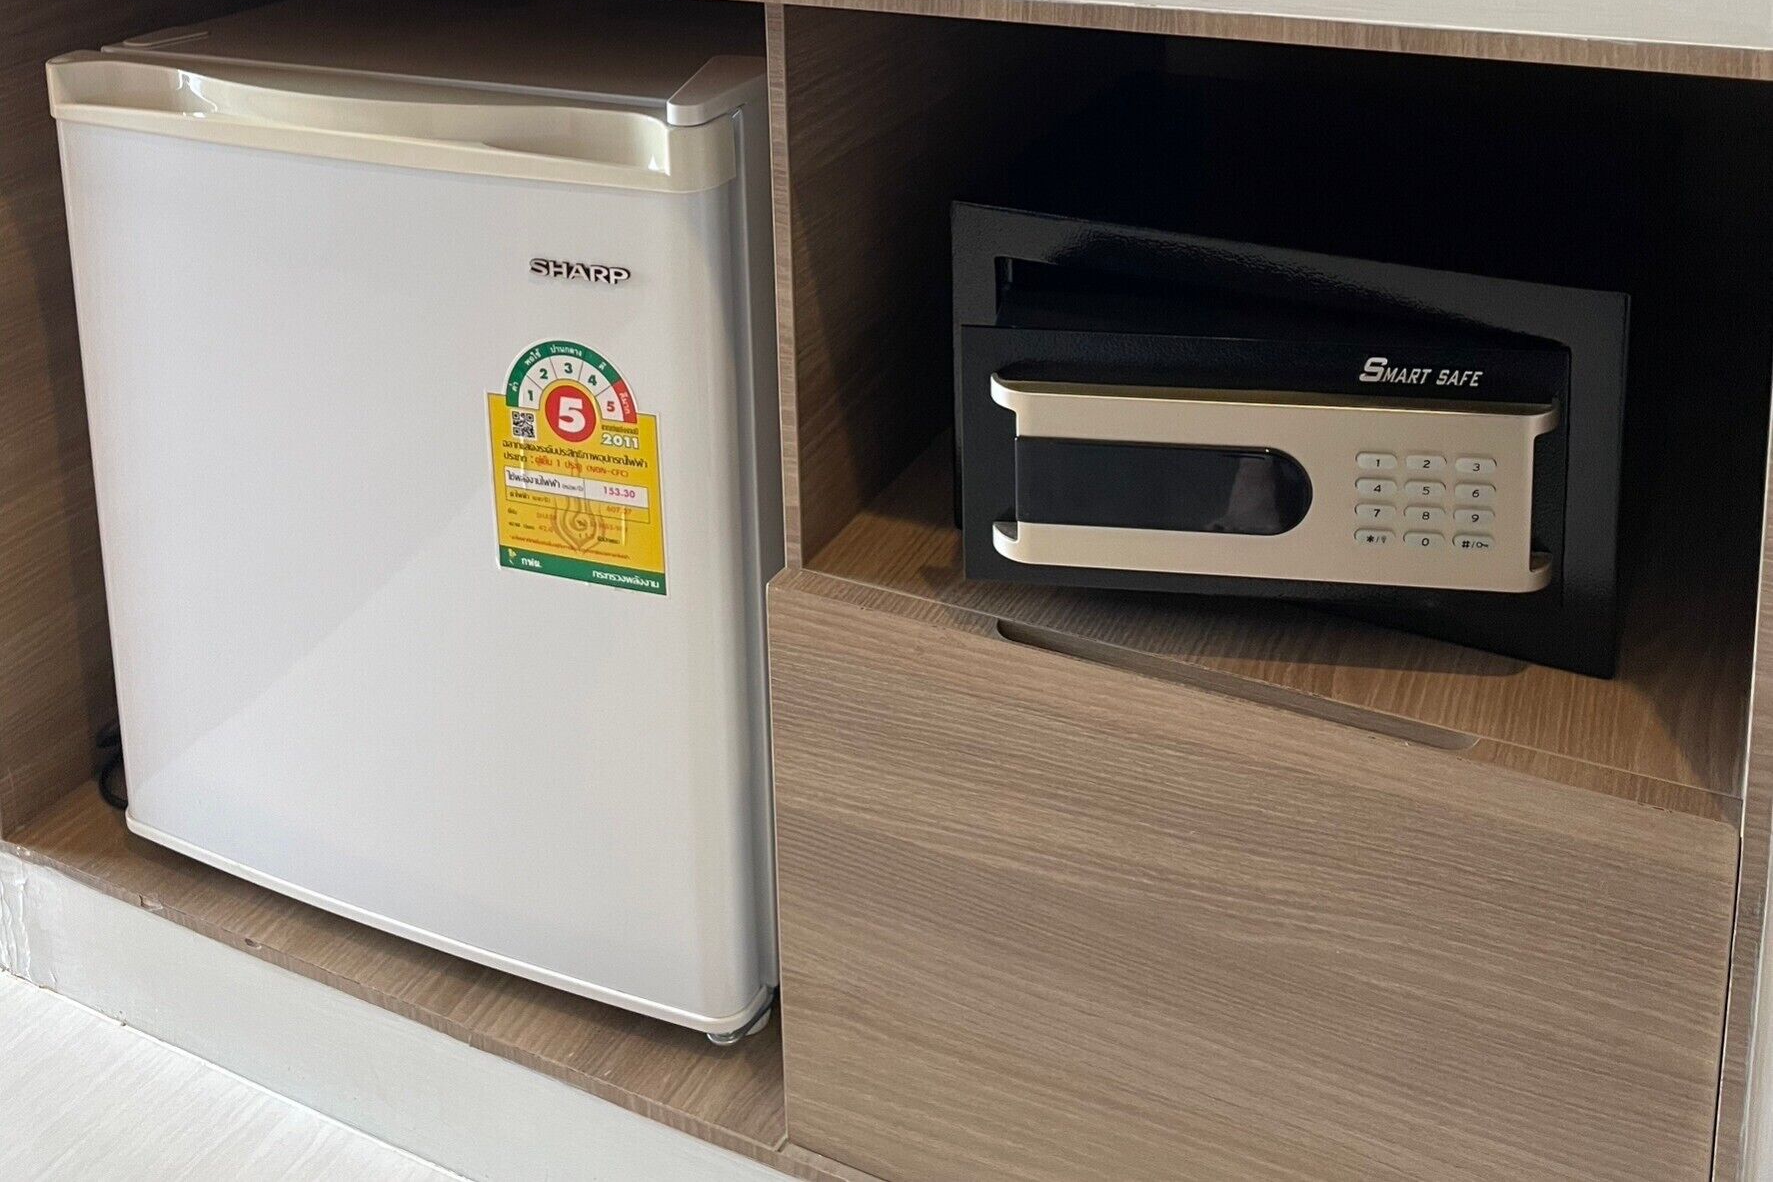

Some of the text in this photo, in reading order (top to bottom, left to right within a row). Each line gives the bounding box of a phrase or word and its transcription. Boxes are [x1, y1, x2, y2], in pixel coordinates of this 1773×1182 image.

[529, 258, 631, 285] SHARP
[564, 362, 573, 374] 3
[539, 368, 549, 380] 2
[1436, 369, 1484, 387] SAFE
[587, 374, 597, 386] 4
[527, 389, 534, 401] 1
[606, 401, 616, 413] 5
[557, 396, 586, 434] 5
[601, 432, 640, 450] 2011
[1376, 459, 1380, 467] 1
[1423, 460, 1431, 468] 2
[1473, 463, 1480, 472] 3
[603, 486, 636, 499] 153.30
[1373, 484, 1381, 493] 4
[1422, 486, 1430, 495] 5
[1472, 490, 1480, 498] 6
[1374, 509, 1381, 517] 7
[1422, 511, 1430, 520] 8
[1472, 514, 1479, 523] 9
[1422, 538, 1429, 546] 0
